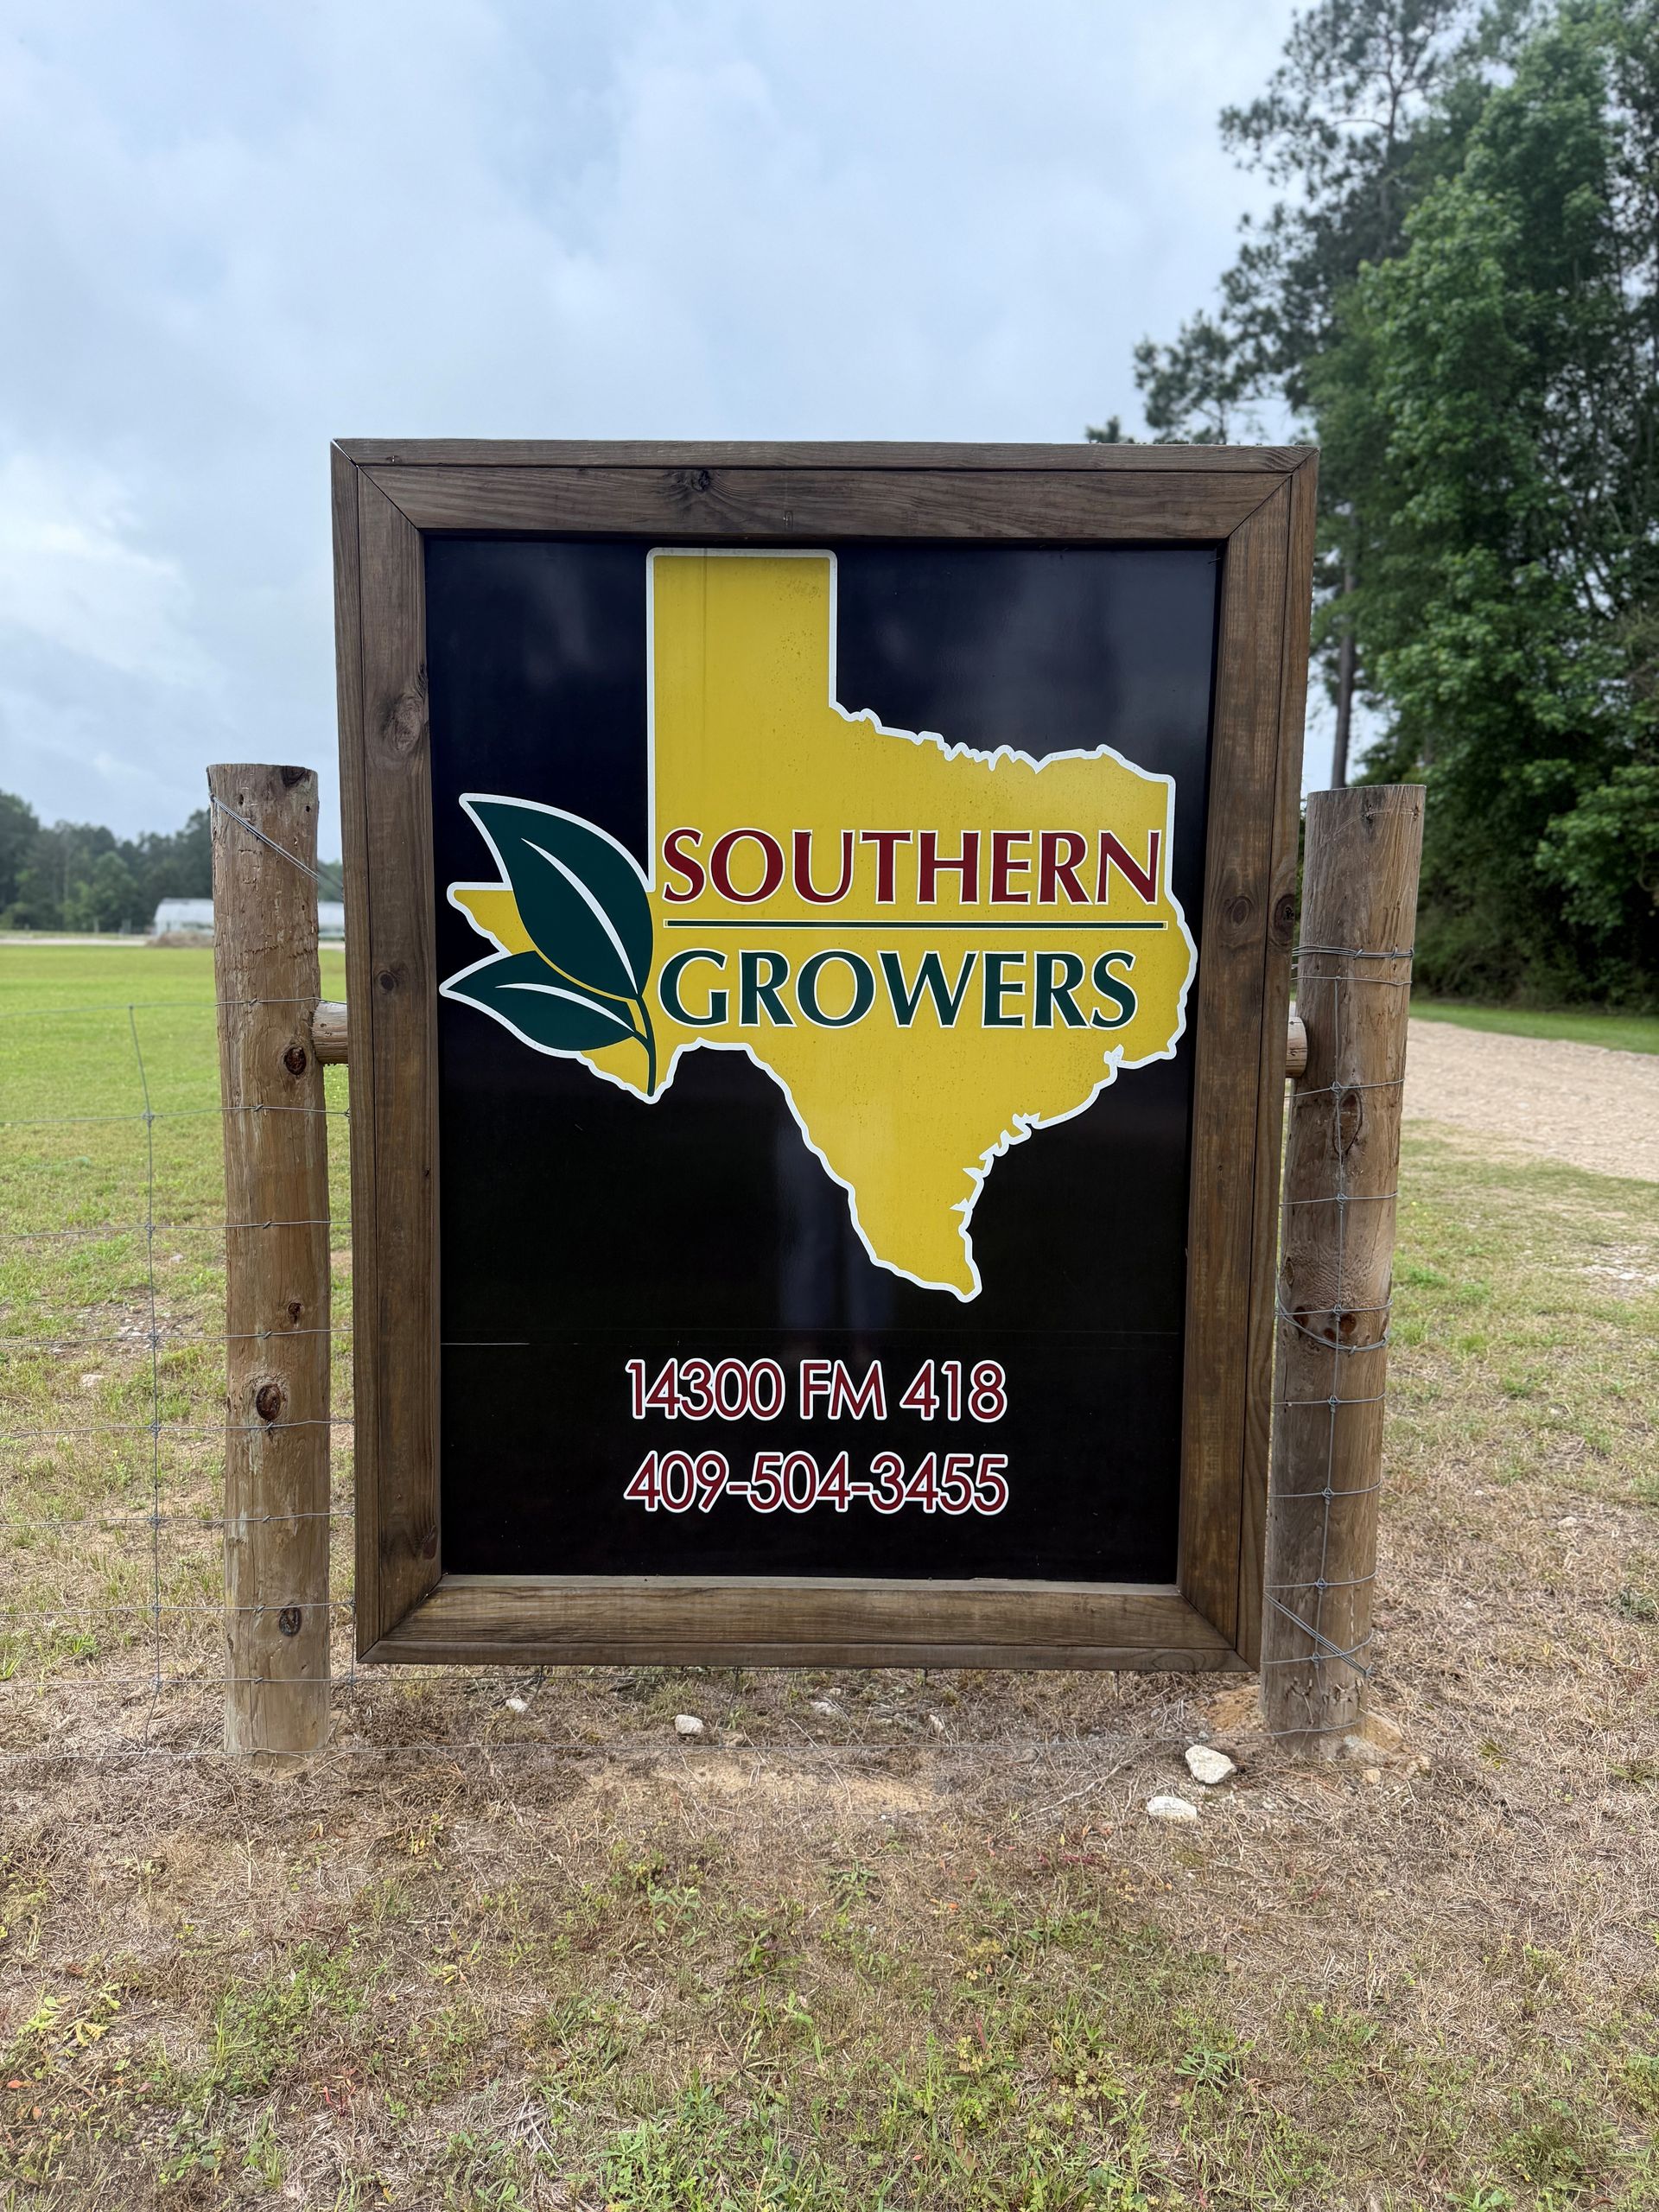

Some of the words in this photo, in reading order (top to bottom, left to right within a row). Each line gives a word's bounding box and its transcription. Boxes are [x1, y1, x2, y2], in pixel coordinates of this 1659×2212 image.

[662, 828, 1161, 906] SOUTHERN
[658, 949, 1139, 1030] GROWERS
[626, 1357, 785, 1421] 14300
[799, 1359, 887, 1420] FM
[900, 1359, 1007, 1422] 418
[624, 1450, 1008, 1516] 409-504-3455
